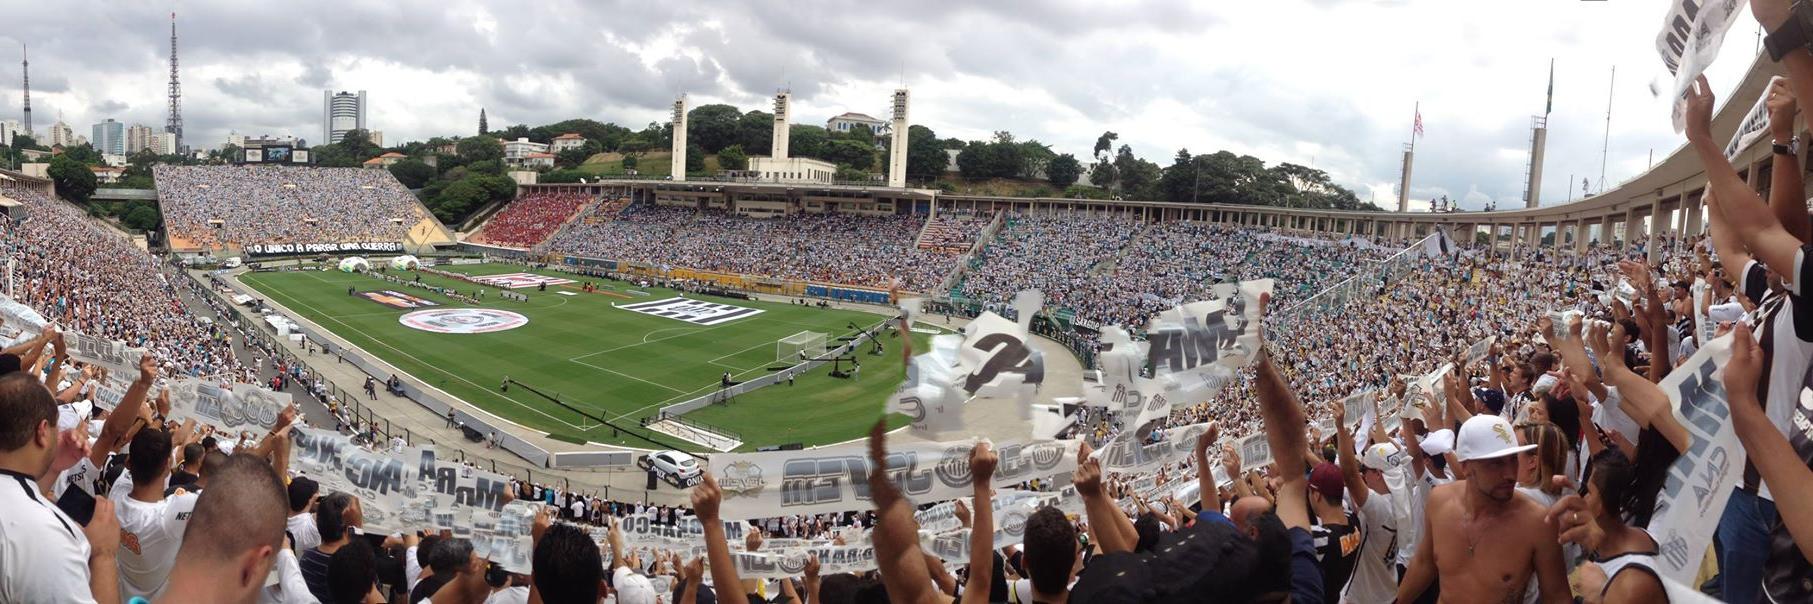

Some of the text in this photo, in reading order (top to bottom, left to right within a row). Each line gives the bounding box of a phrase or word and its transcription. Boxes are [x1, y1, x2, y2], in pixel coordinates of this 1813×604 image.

[255, 244, 262, 253] O
[296, 243, 304, 252] A
[306, 243, 339, 252] PARAR
[361, 242, 396, 251] GUERRA
